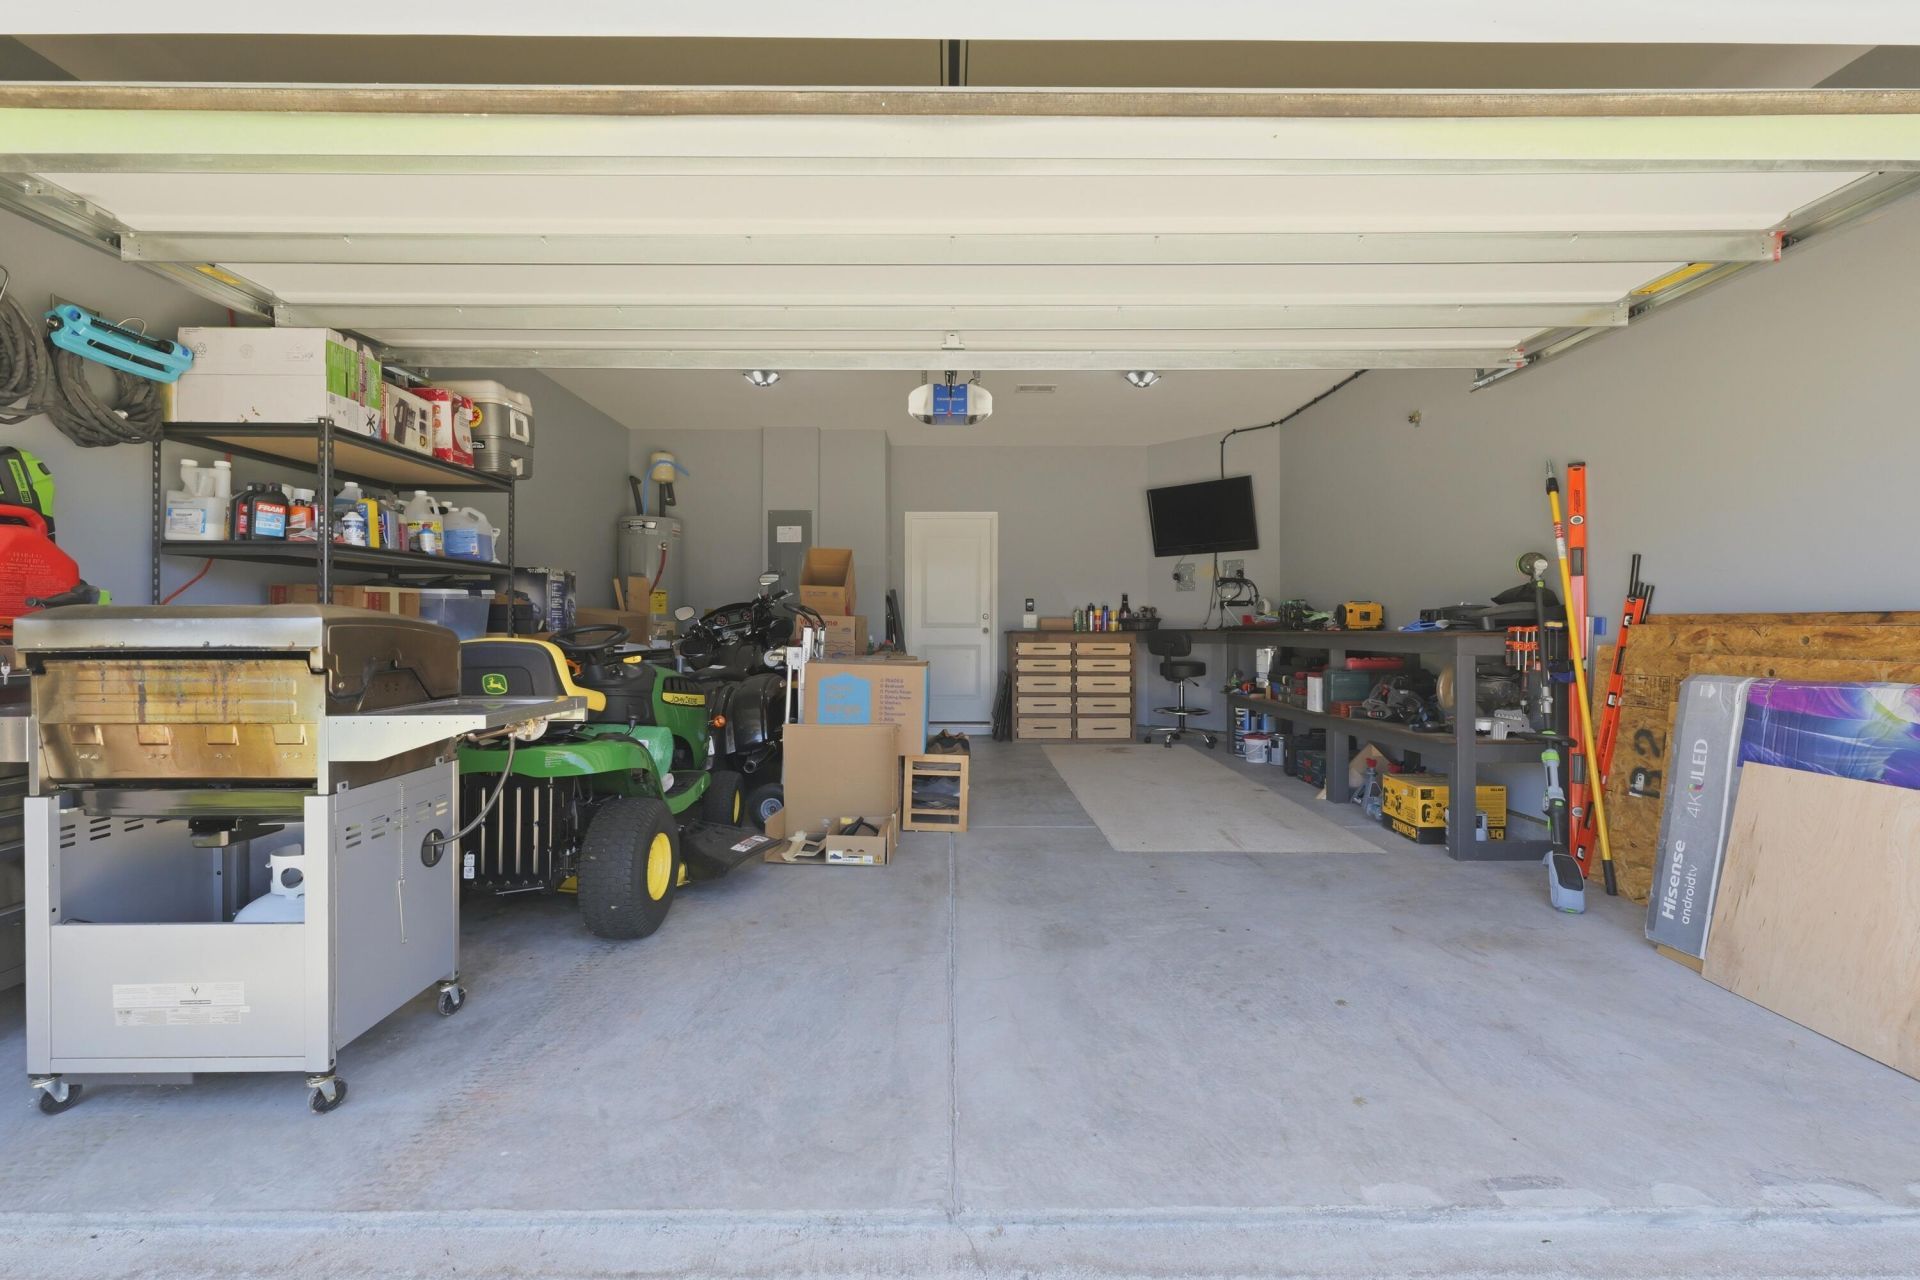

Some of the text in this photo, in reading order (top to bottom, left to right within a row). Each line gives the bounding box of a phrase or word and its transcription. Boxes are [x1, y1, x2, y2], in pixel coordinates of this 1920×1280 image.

[257, 504, 284, 514] FRAM
[1392, 818, 1417, 839] DEWALT
[1662, 839, 1686, 920] Hisense
